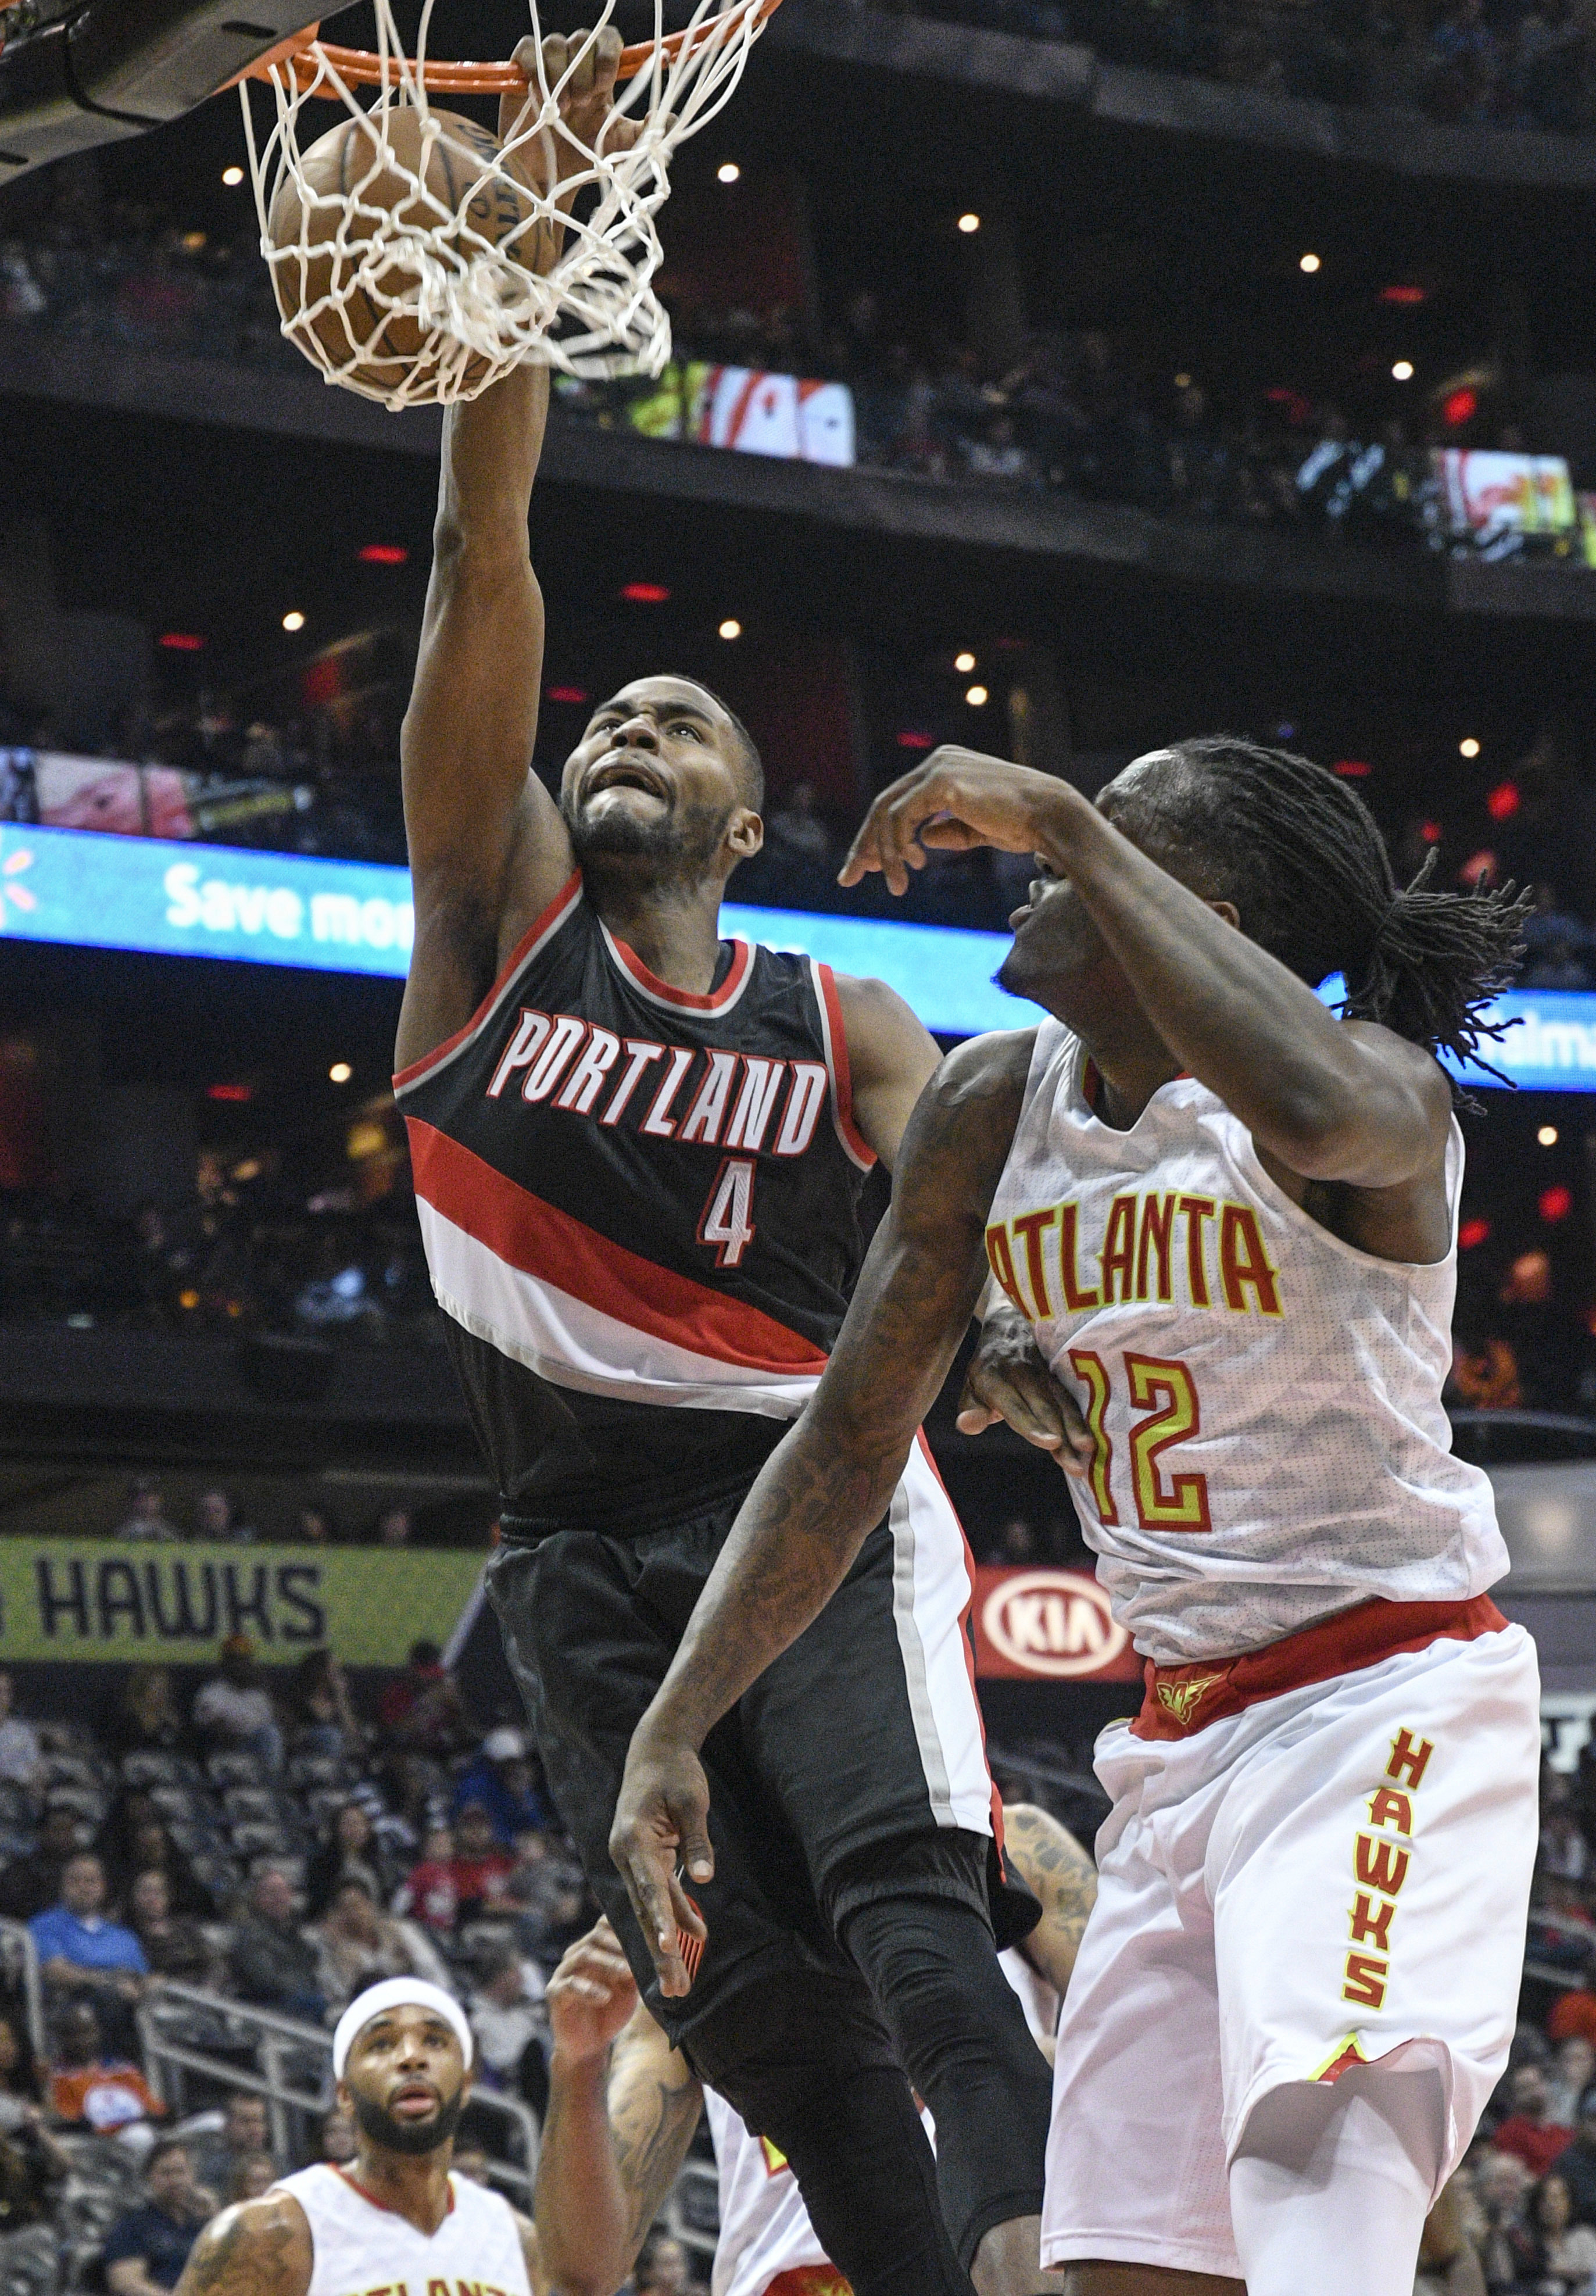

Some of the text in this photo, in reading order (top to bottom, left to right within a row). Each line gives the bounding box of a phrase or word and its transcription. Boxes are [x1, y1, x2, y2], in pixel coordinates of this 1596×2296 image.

[164, 862, 302, 939] Save
[486, 1007, 829, 1157] PORTLAND
[697, 1157, 756, 1268] 4
[985, 1190, 1284, 1323] ATLANTA
[1068, 1347, 1212, 1532] 12
[34, 1556, 327, 1642] HAWKS
[1007, 1596, 1109, 1653] KIA
[1340, 1726, 1435, 2012] HAWKS
